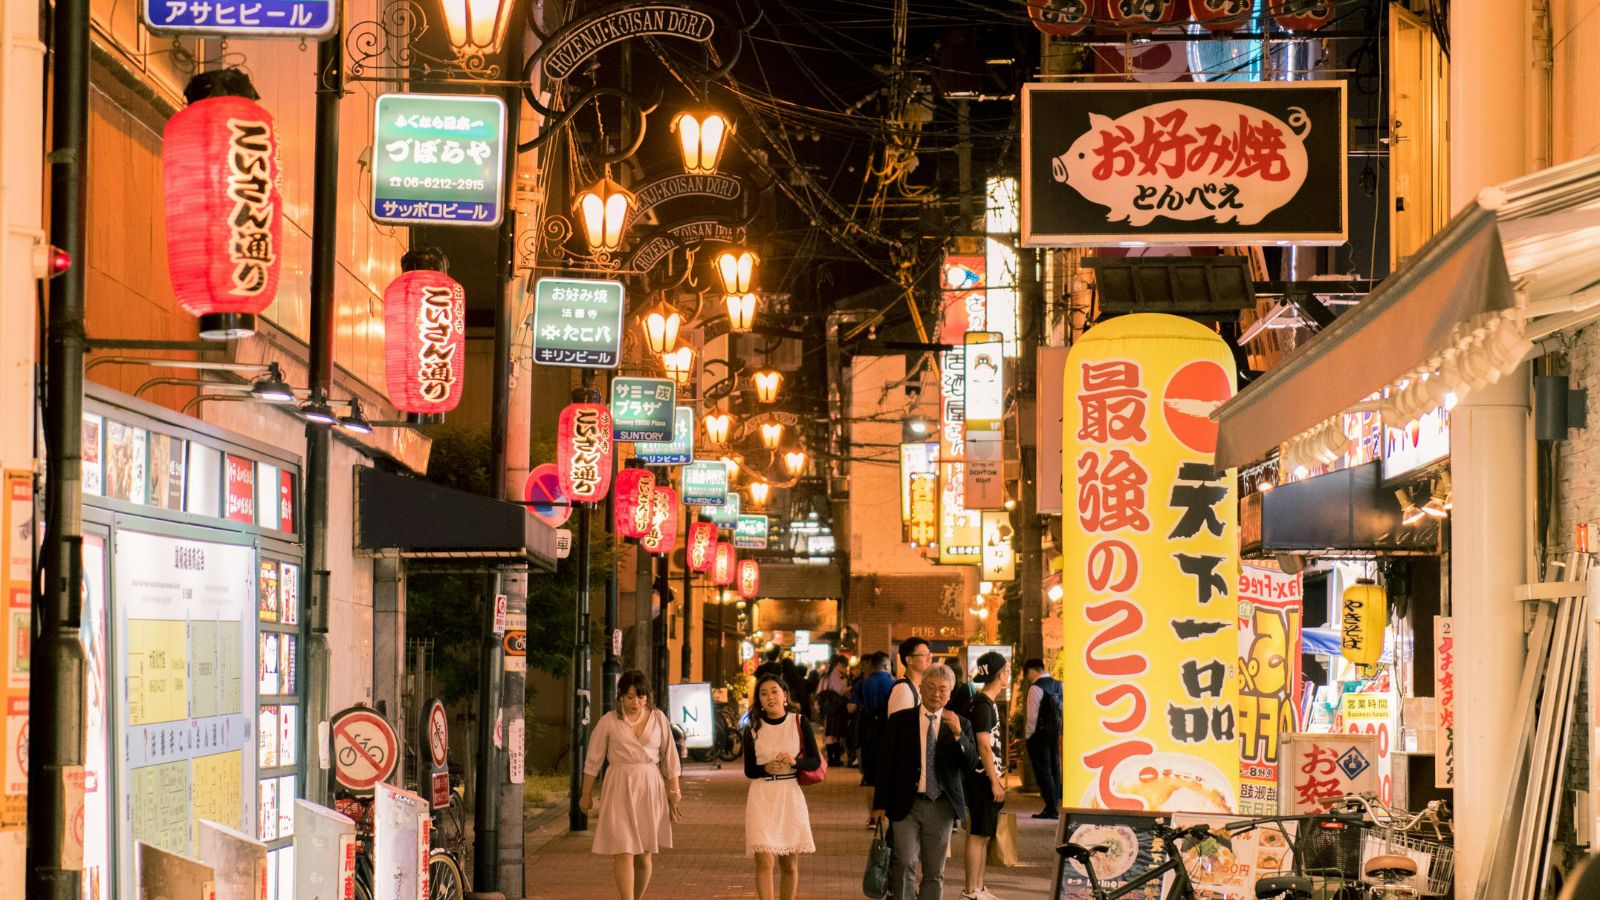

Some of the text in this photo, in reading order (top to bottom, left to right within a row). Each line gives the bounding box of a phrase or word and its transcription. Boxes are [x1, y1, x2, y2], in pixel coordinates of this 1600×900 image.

[164, 1, 314, 25] アサヒビール
[385, 138, 492, 166] づぼらや
[1092, 108, 1291, 181] お好み焼
[228, 118, 275, 296] こいさん通り
[1133, 183, 1244, 210] とんべえ
[383, 201, 488, 219] サッポロビール
[552, 287, 608, 303] お好み焼
[418, 286, 456, 402] こいさん通り
[541, 349, 611, 364] キリンビール
[616, 384, 655, 398] サミー
[615, 400, 662, 416] プラザ
[620, 431, 664, 440] SUNTORY
[570, 408, 602, 496] こいさん通り
[1167, 462, 1235, 743] 天下一品
[912, 627, 935, 637] PUB
[683, 705, 698, 723] N
[1347, 699, 1388, 710] 営業時間
[1295, 744, 1344, 815] お好
